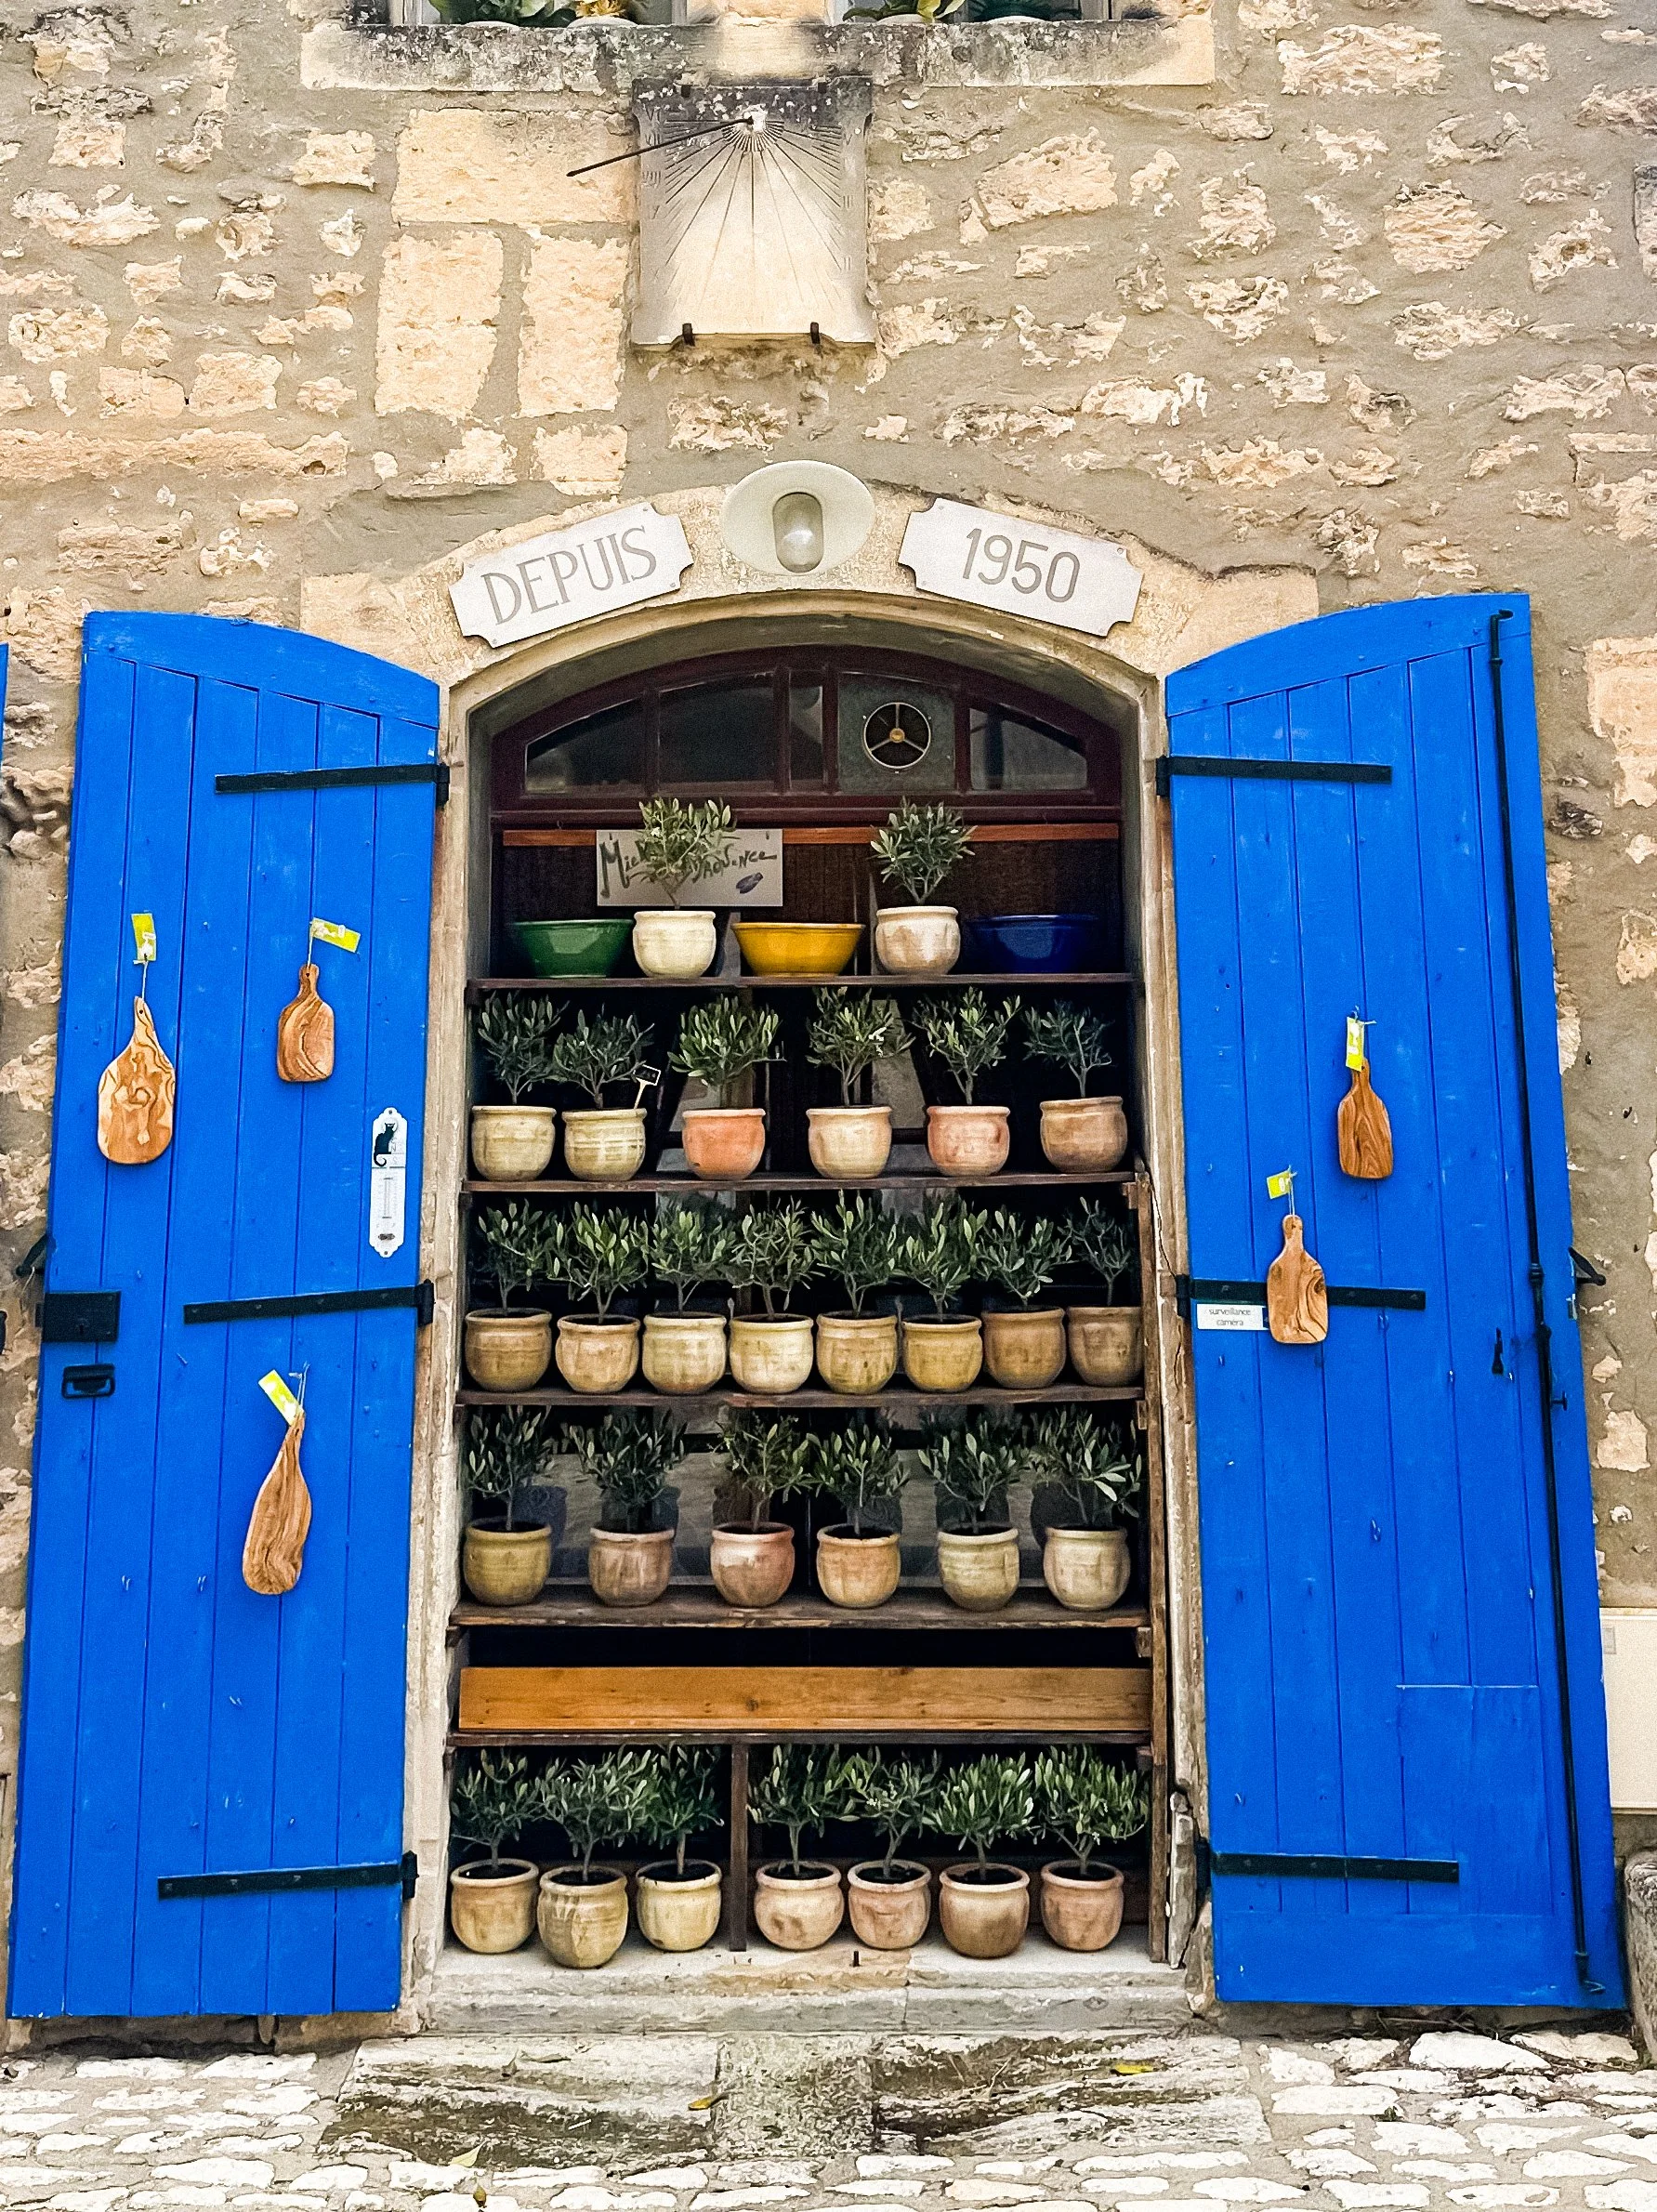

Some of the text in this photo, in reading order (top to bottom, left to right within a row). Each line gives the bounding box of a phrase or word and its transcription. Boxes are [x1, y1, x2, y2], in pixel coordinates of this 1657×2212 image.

[480, 525, 657, 625] DEPUIS
[963, 528, 1081, 603] 1950
[1209, 1307, 1251, 1316] surveillance
